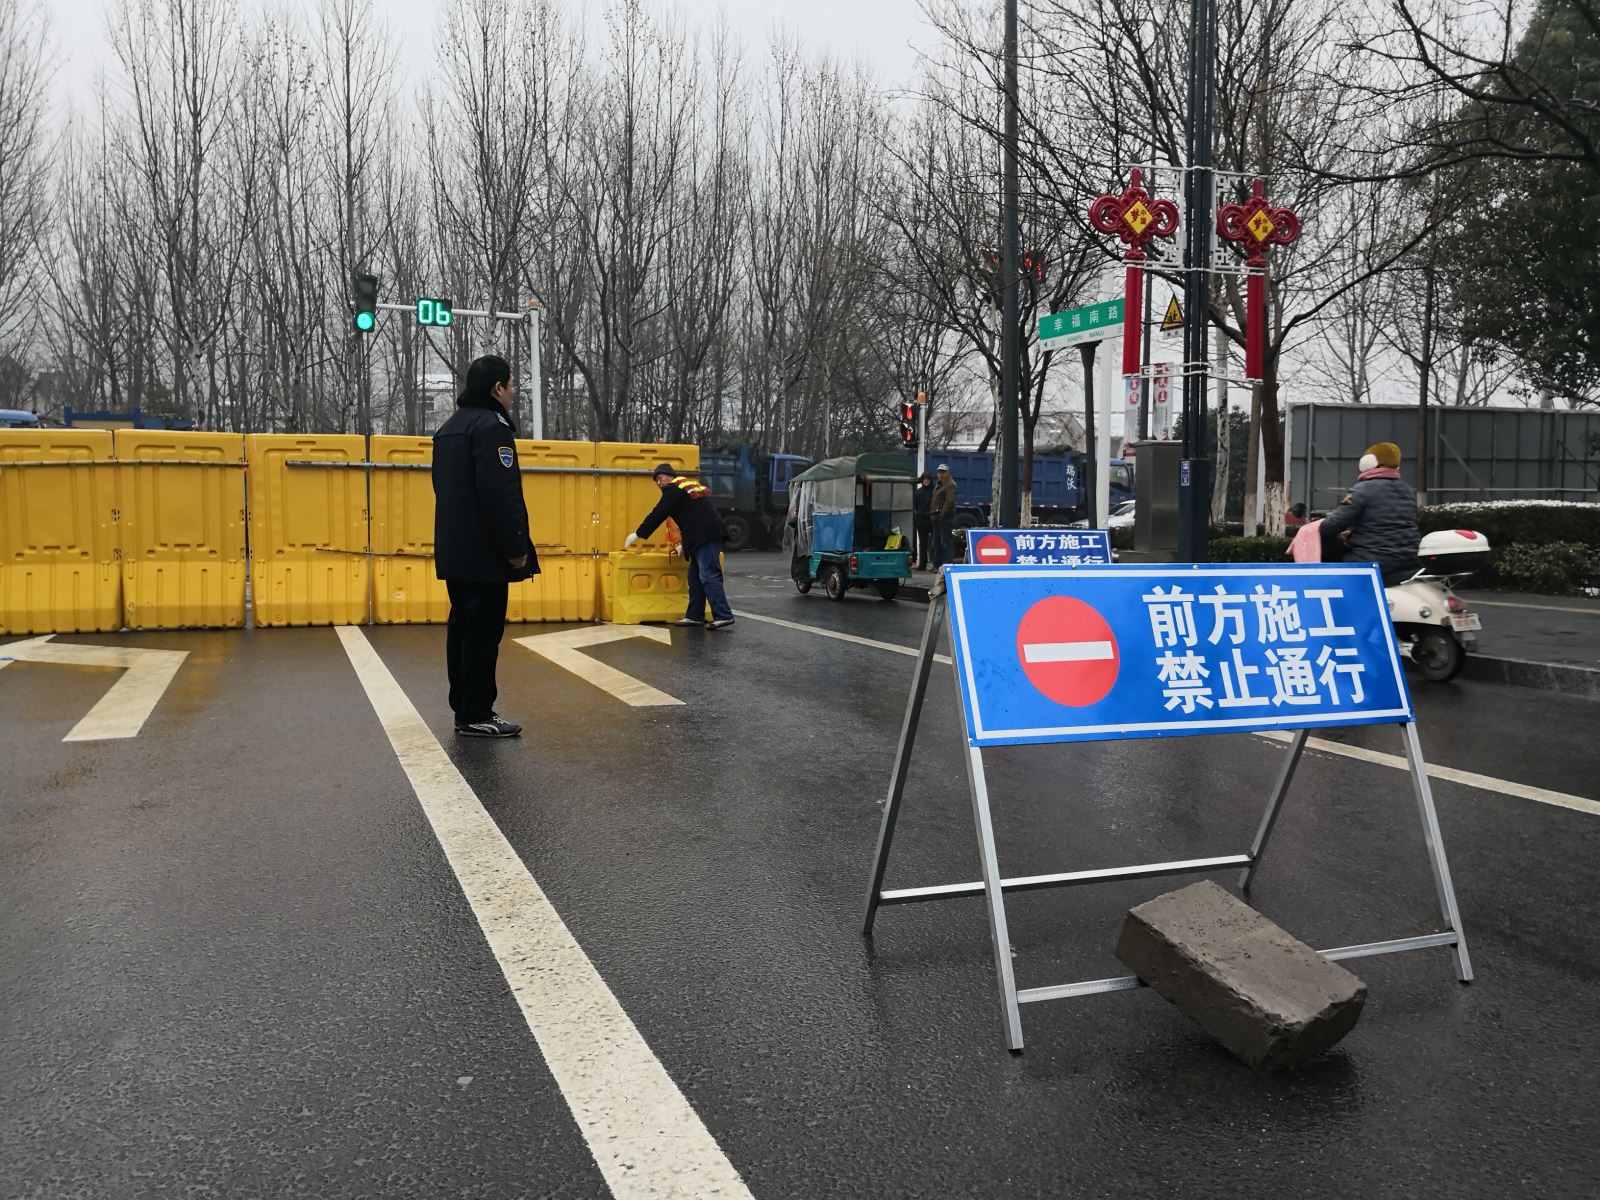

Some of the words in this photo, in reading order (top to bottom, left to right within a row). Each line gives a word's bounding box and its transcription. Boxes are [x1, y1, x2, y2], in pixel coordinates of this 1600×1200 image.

[418, 300, 450, 325] 06
[1053, 305, 1118, 332] 幸福南路
[1014, 534, 1103, 550] 前方施工
[1142, 584, 1356, 647] 前方施工
[1156, 645, 1366, 714] 禁止通行
